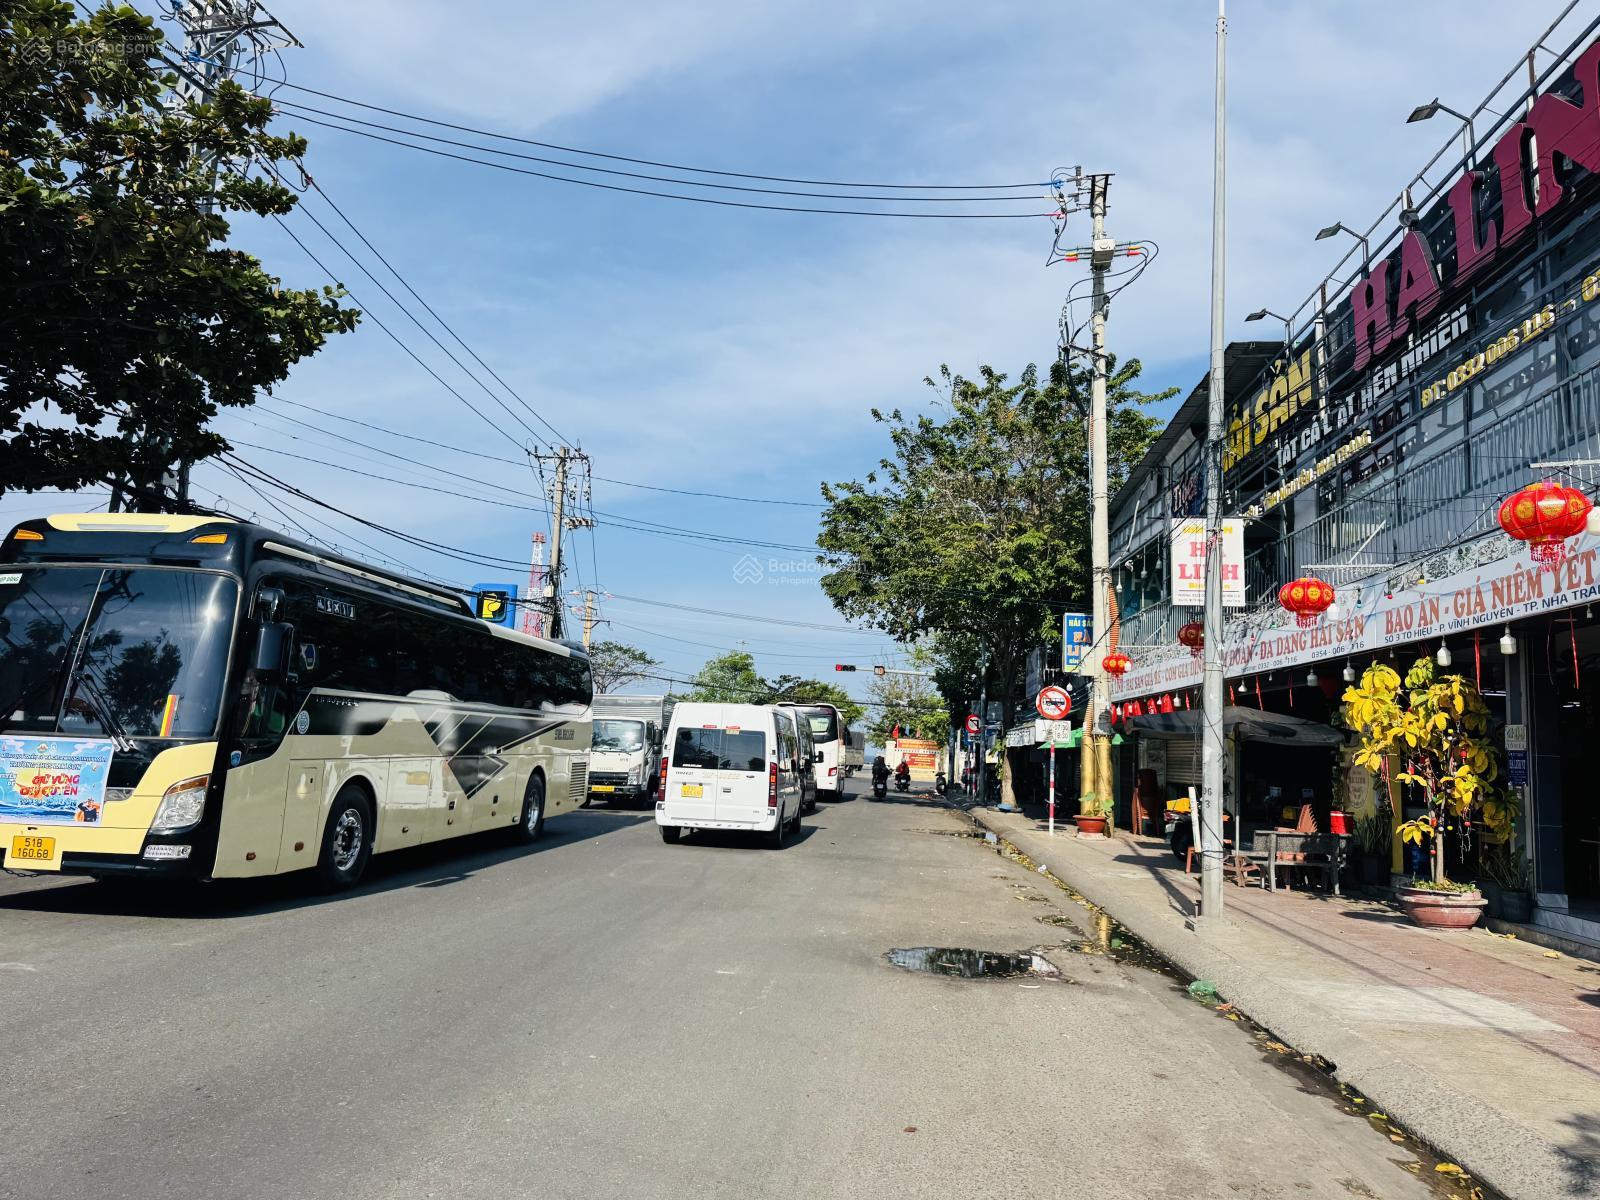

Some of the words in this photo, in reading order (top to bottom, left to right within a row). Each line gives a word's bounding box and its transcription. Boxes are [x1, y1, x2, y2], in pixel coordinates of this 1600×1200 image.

[1401, 303, 1469, 378] NHIÊN
[1447, 352, 1486, 392] 0332
[1485, 328, 1520, 365] 006
[1254, 349, 1312, 446] SẢN
[1178, 563, 1239, 580] LIH
[1384, 604, 1414, 635] BAO
[1418, 592, 1440, 627] ĂN
[1453, 575, 1486, 619] GIÁ
[1491, 562, 1544, 609] NIÊM
[1549, 537, 1597, 594] YẾT
[1448, 618, 1470, 630] VĨNH
[1473, 606, 1514, 625] NGUYÊN
[1524, 602, 1539, 612] TP.
[1542, 594, 1569, 608] NHA
[1260, 640, 1273, 661] ĐA
[1312, 650, 1328, 659] 0354
[18, 847, 49, 859] 160.68
